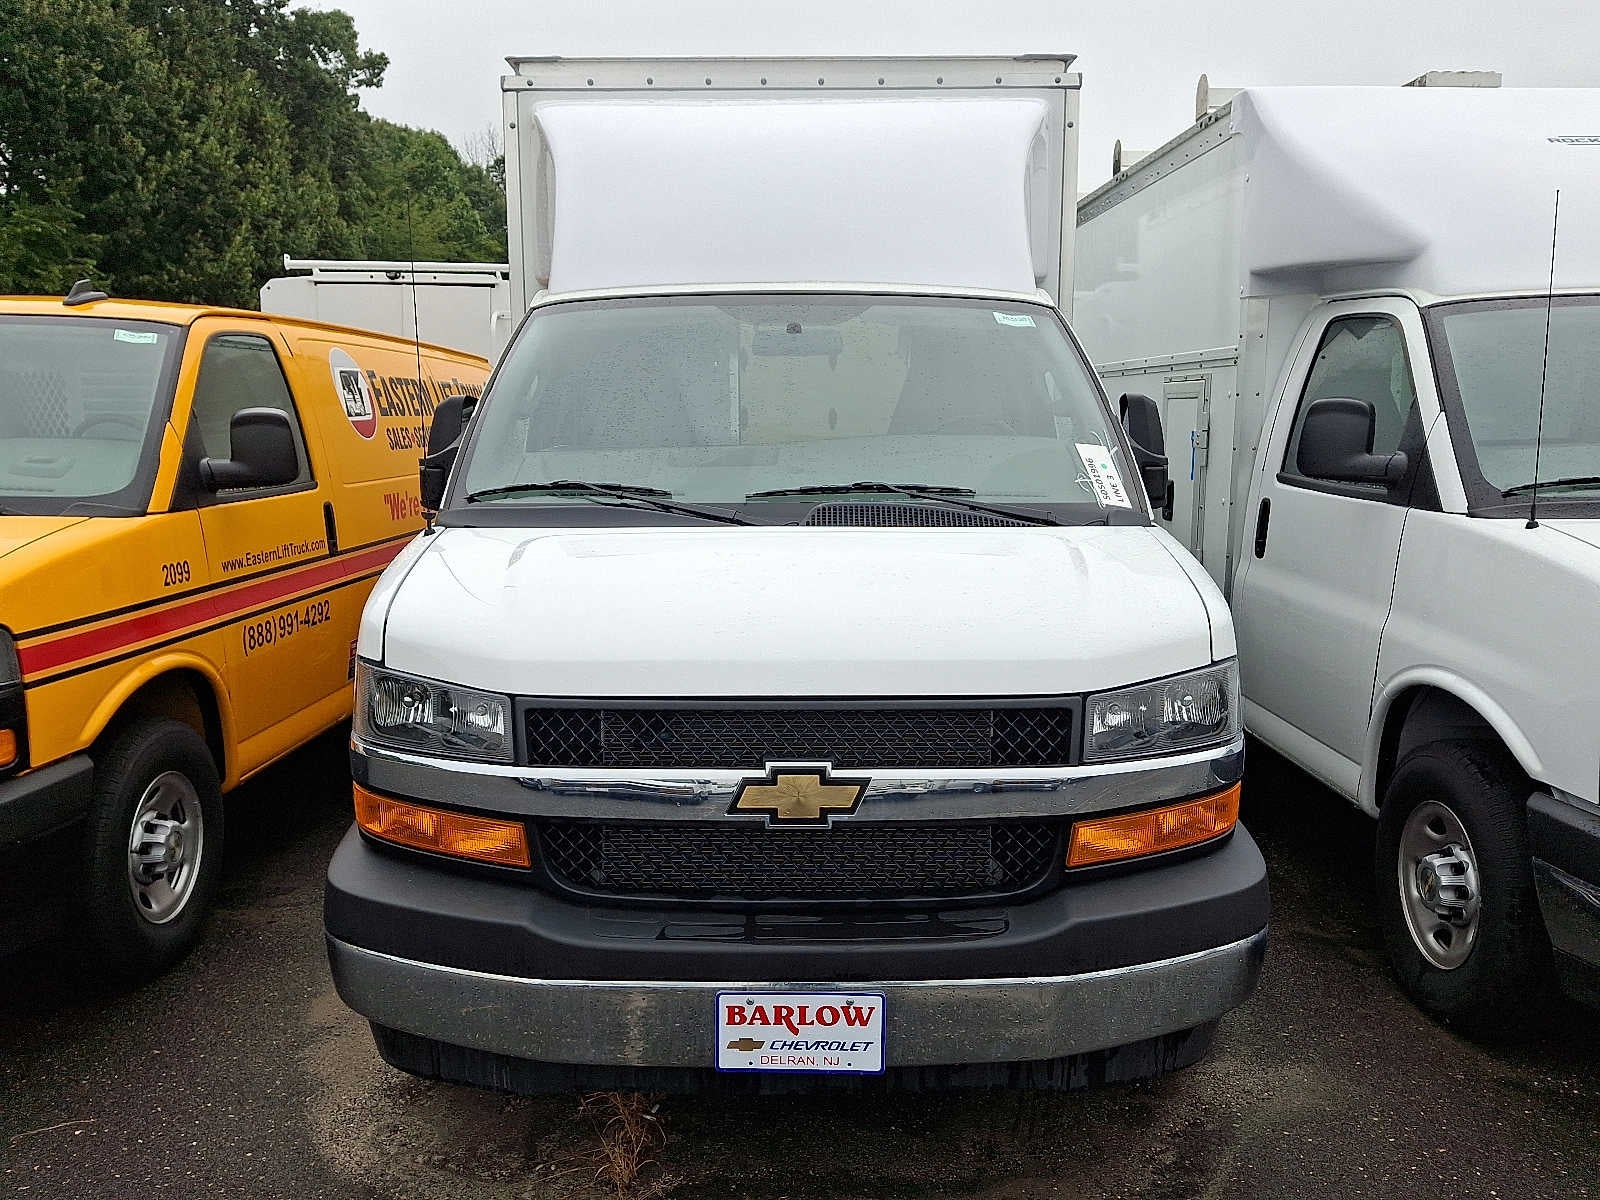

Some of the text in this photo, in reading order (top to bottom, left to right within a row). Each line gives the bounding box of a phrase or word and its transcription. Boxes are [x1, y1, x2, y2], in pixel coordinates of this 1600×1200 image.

[366, 370, 434, 417] EASTERN
[386, 427, 413, 450] SALES
[221, 539, 325, 572] www.EasternLiftTruck.com
[162, 560, 191, 587] 2099
[726, 1005, 875, 1036] BARLOW
[769, 1040, 874, 1052] CHEVROLET
[760, 1055, 840, 1067] DELRAN, NJ
